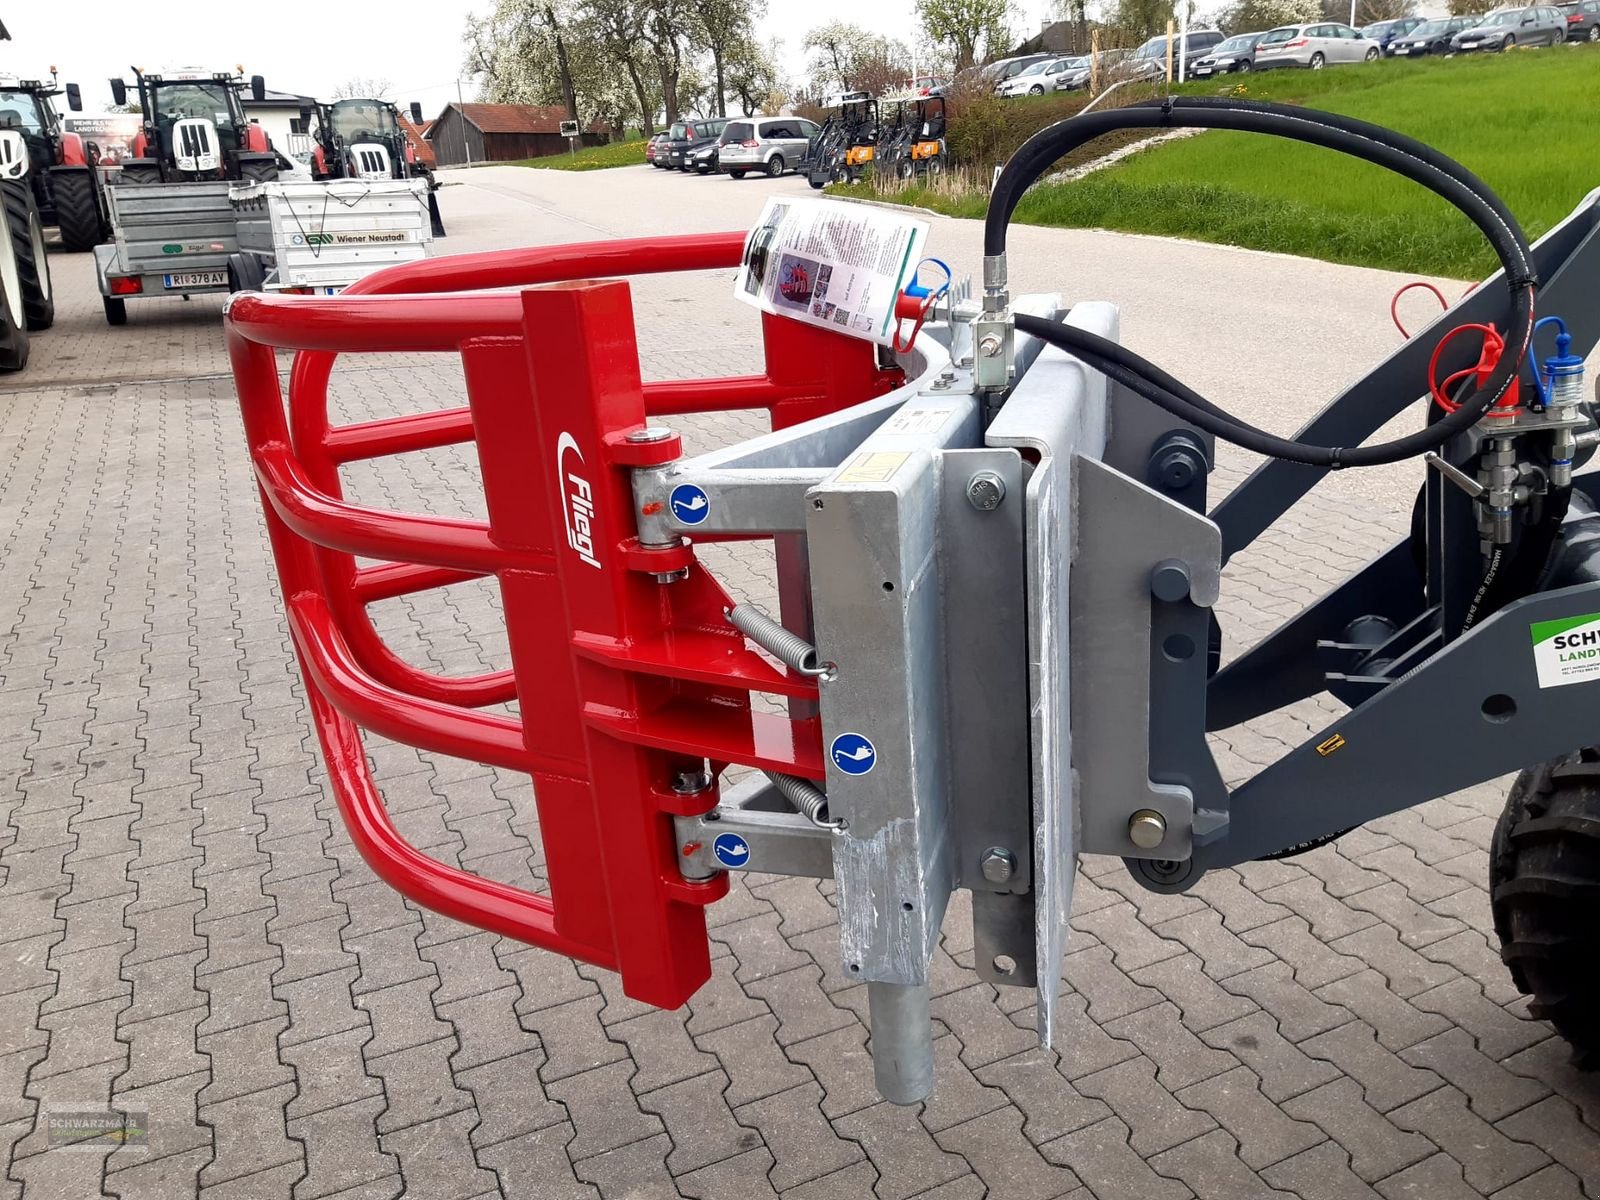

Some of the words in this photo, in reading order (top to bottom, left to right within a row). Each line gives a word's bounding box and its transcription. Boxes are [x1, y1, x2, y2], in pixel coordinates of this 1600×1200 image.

[337, 235, 366, 243] Wiener
[368, 233, 405, 242] Neustadt
[173, 275, 184, 285] RI
[191, 274, 210, 284] 378
[212, 273, 224, 283] AV
[567, 472, 602, 570] Fliegl
